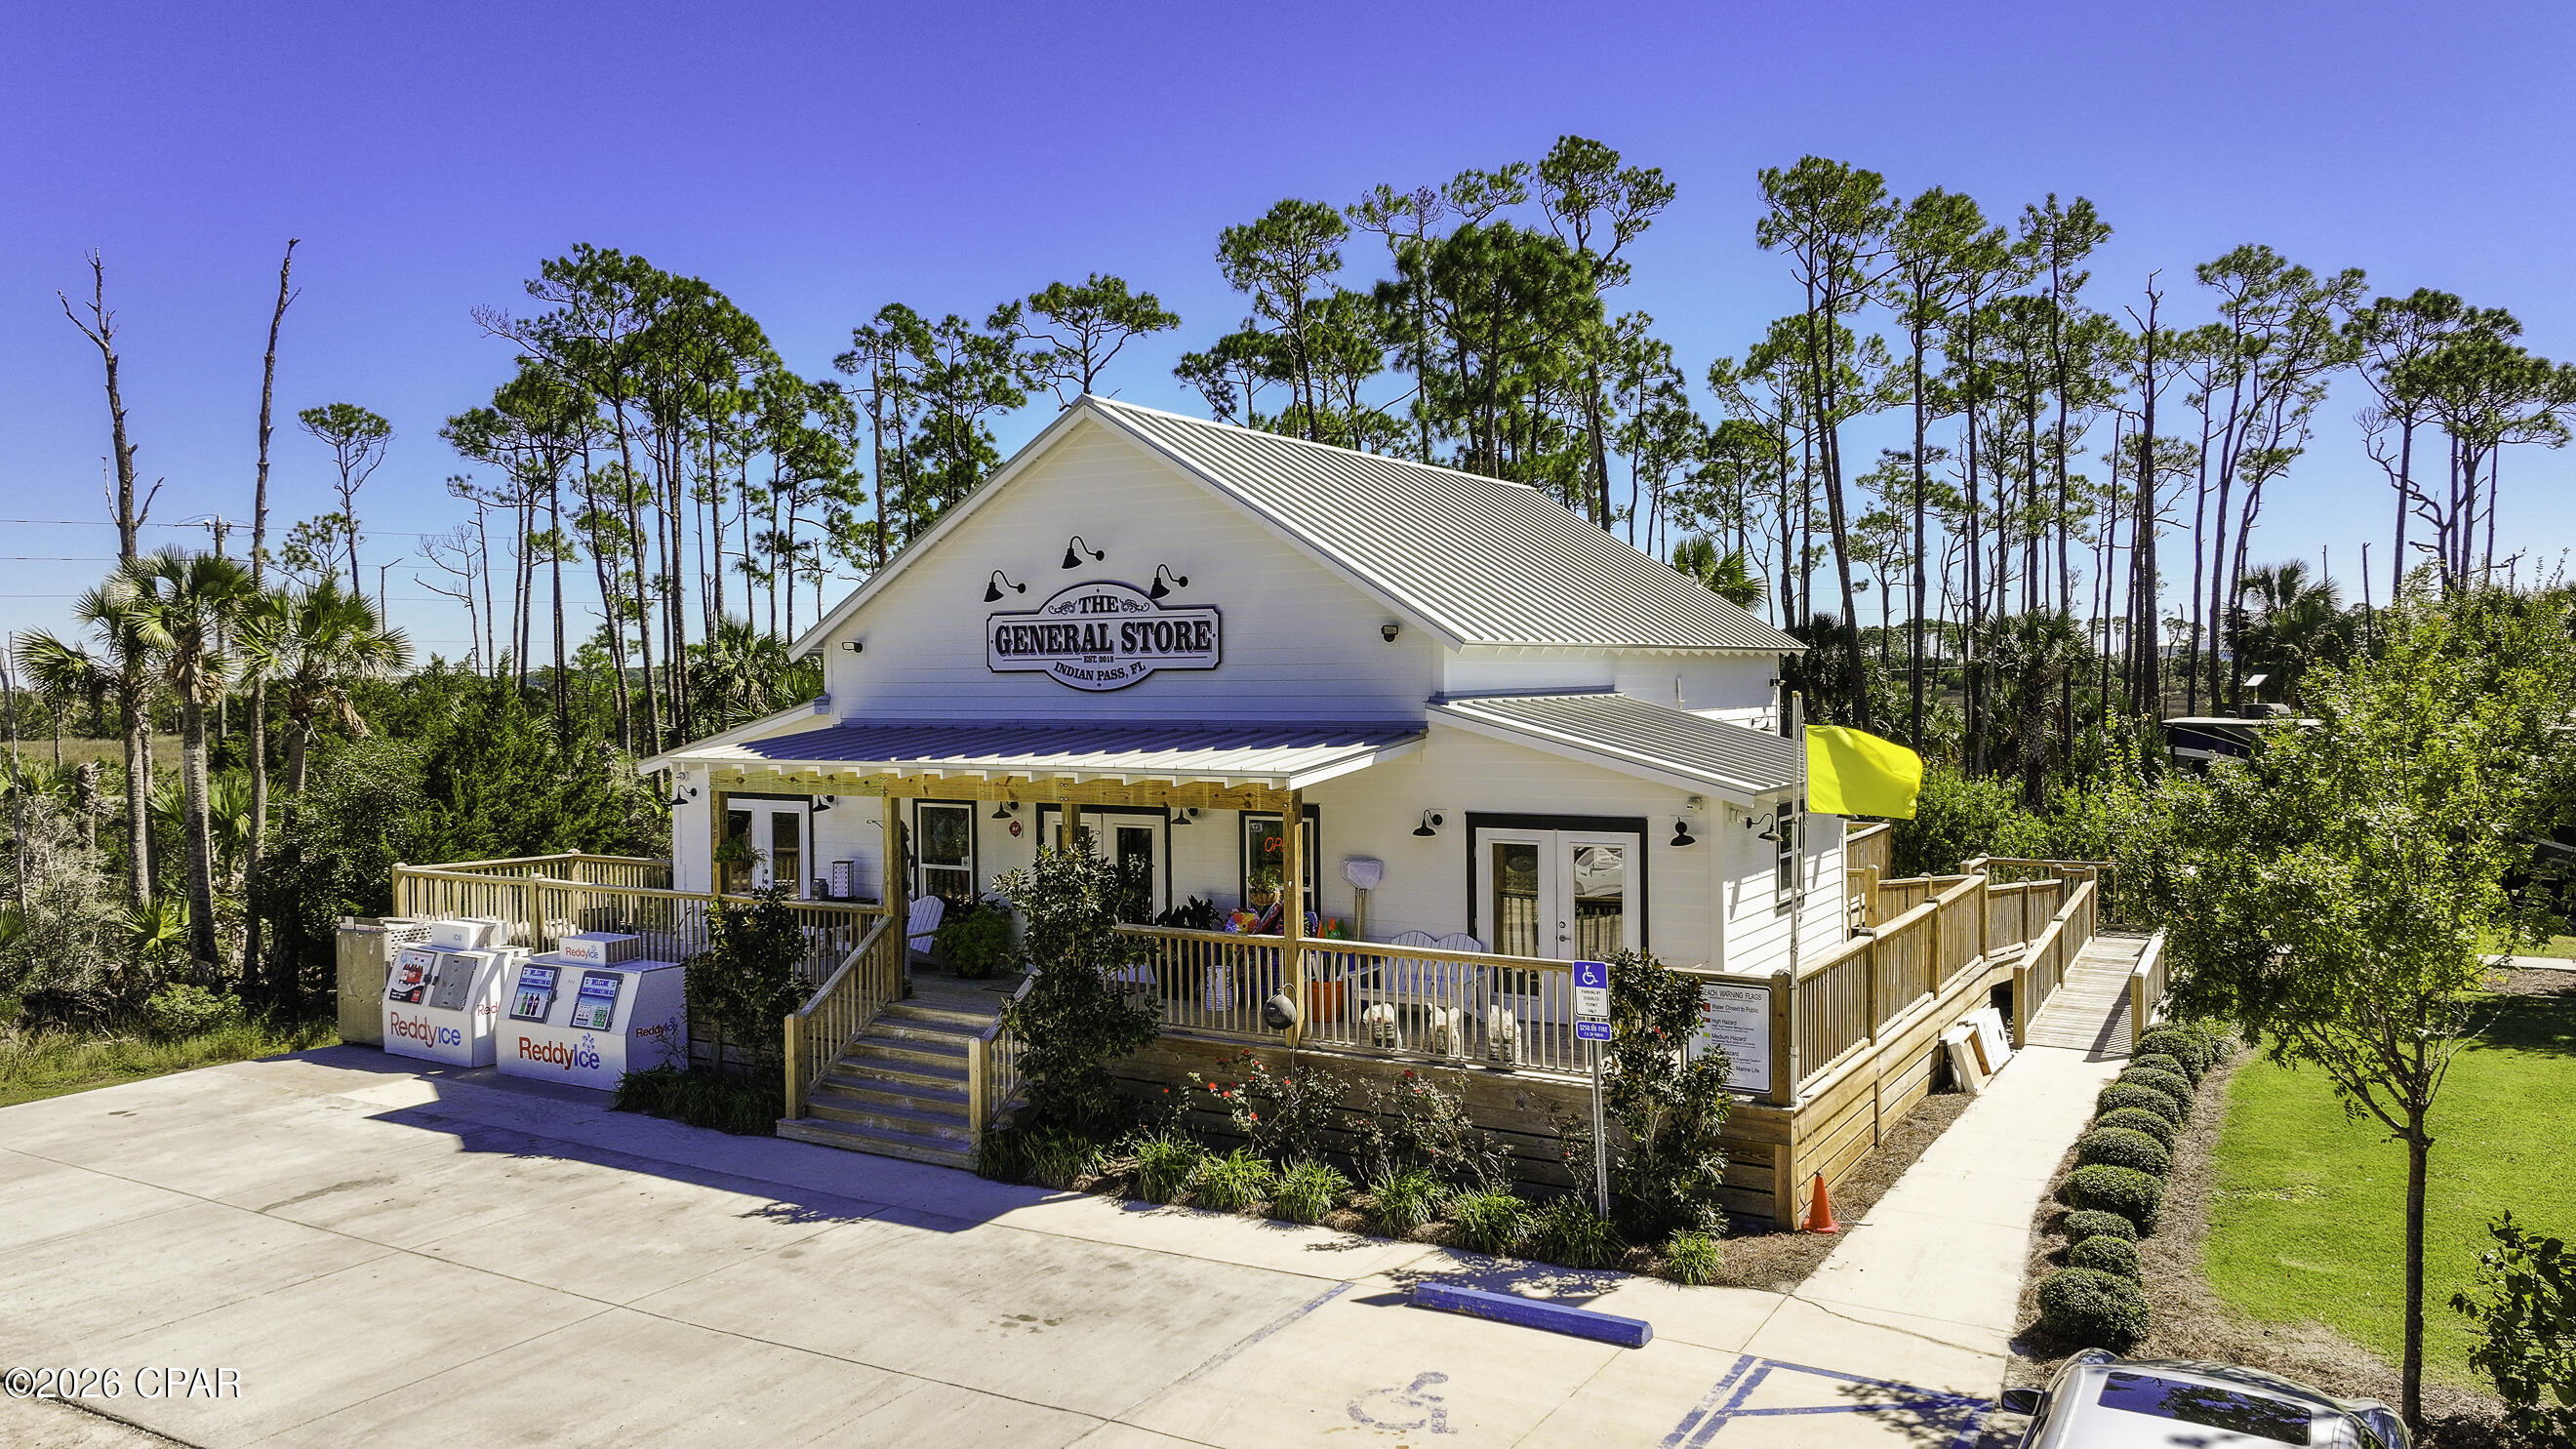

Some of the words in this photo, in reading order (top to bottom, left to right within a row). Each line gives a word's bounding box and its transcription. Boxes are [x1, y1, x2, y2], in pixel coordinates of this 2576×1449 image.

[1078, 595, 1120, 615] THE
[994, 623, 1115, 657] GENERAL
[1121, 620, 1212, 654] STORE
[1099, 655, 1114, 664] 2018
[1053, 661, 1095, 681] INDIAN
[1096, 665, 1129, 681] PASS,
[1130, 660, 1147, 674] FL
[1265, 836, 1284, 853] OP
[590, 979, 609, 987] WELCOME
[1719, 990, 1744, 999] WARNING
[1745, 992, 1762, 1001] FLAGS
